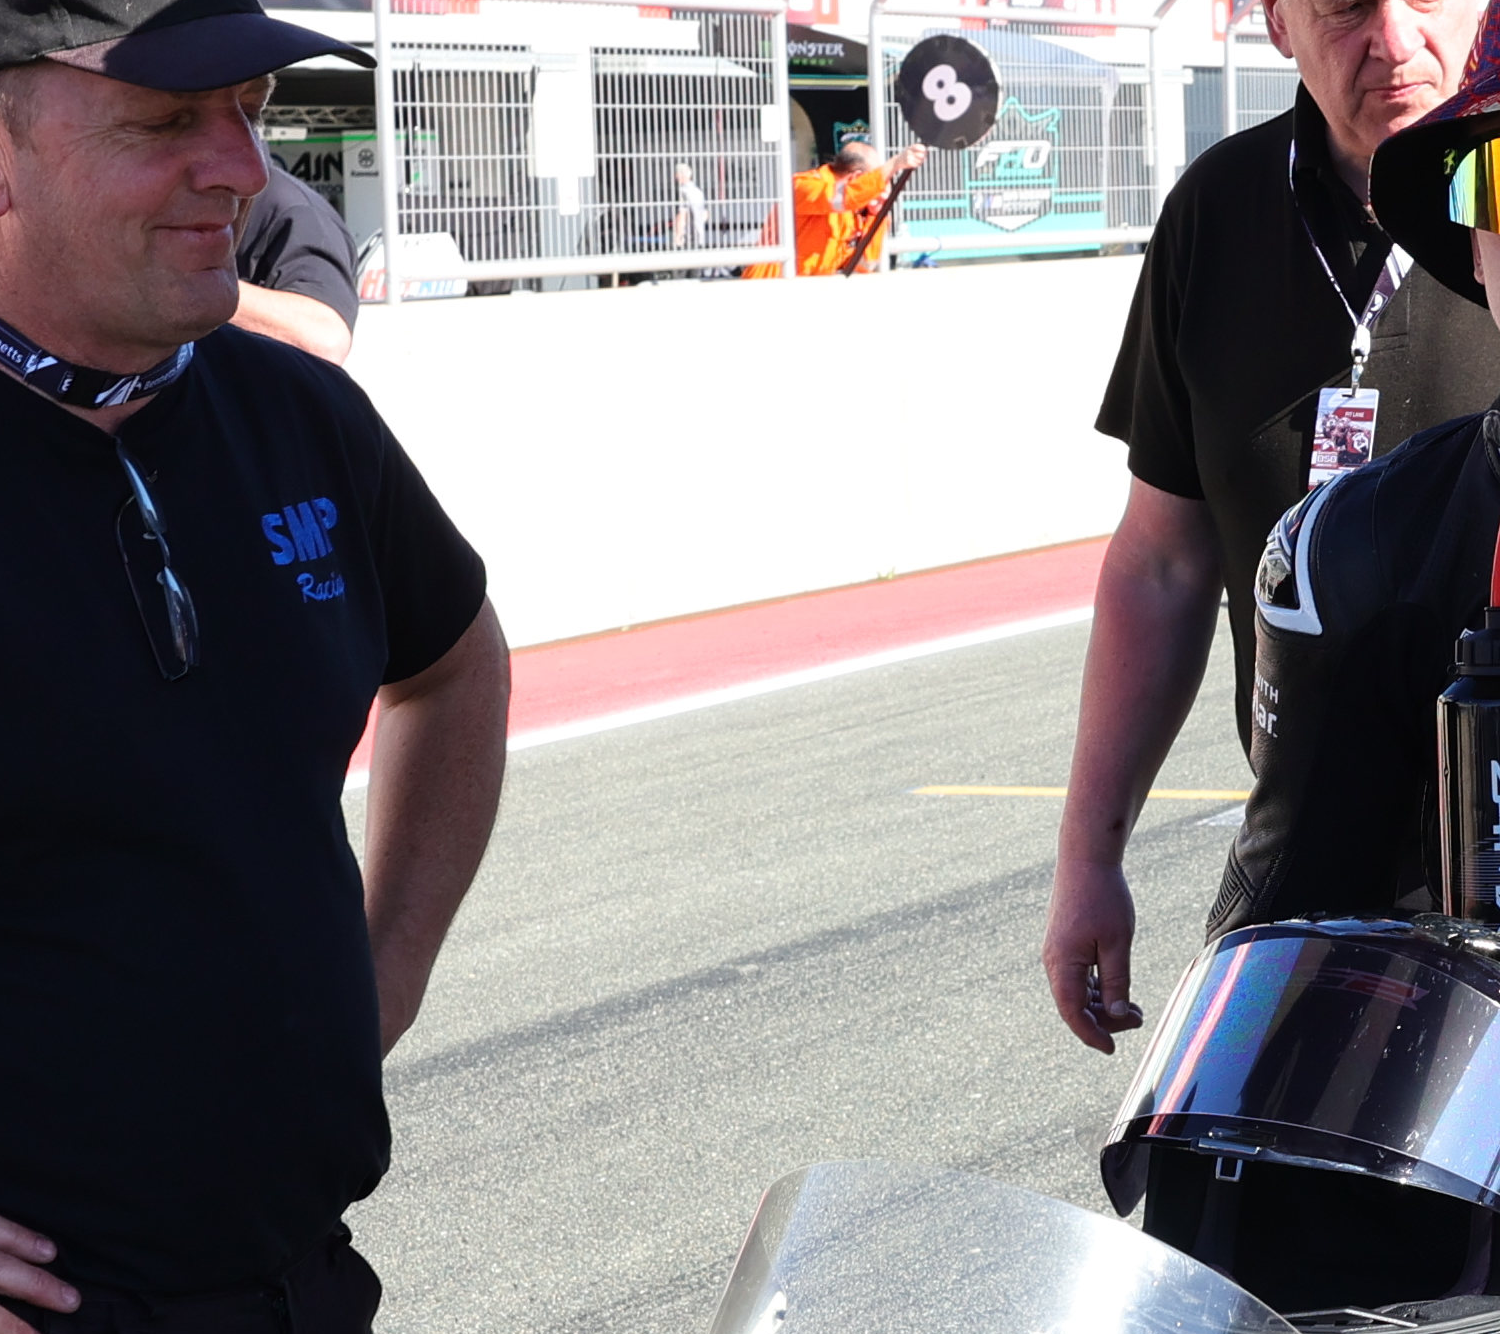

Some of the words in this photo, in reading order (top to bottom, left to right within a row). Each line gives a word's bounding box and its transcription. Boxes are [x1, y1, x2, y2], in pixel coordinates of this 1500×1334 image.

[786, 42, 845, 58] ONSTER
[921, 64, 973, 122] 8
[261, 497, 340, 566] SMP
